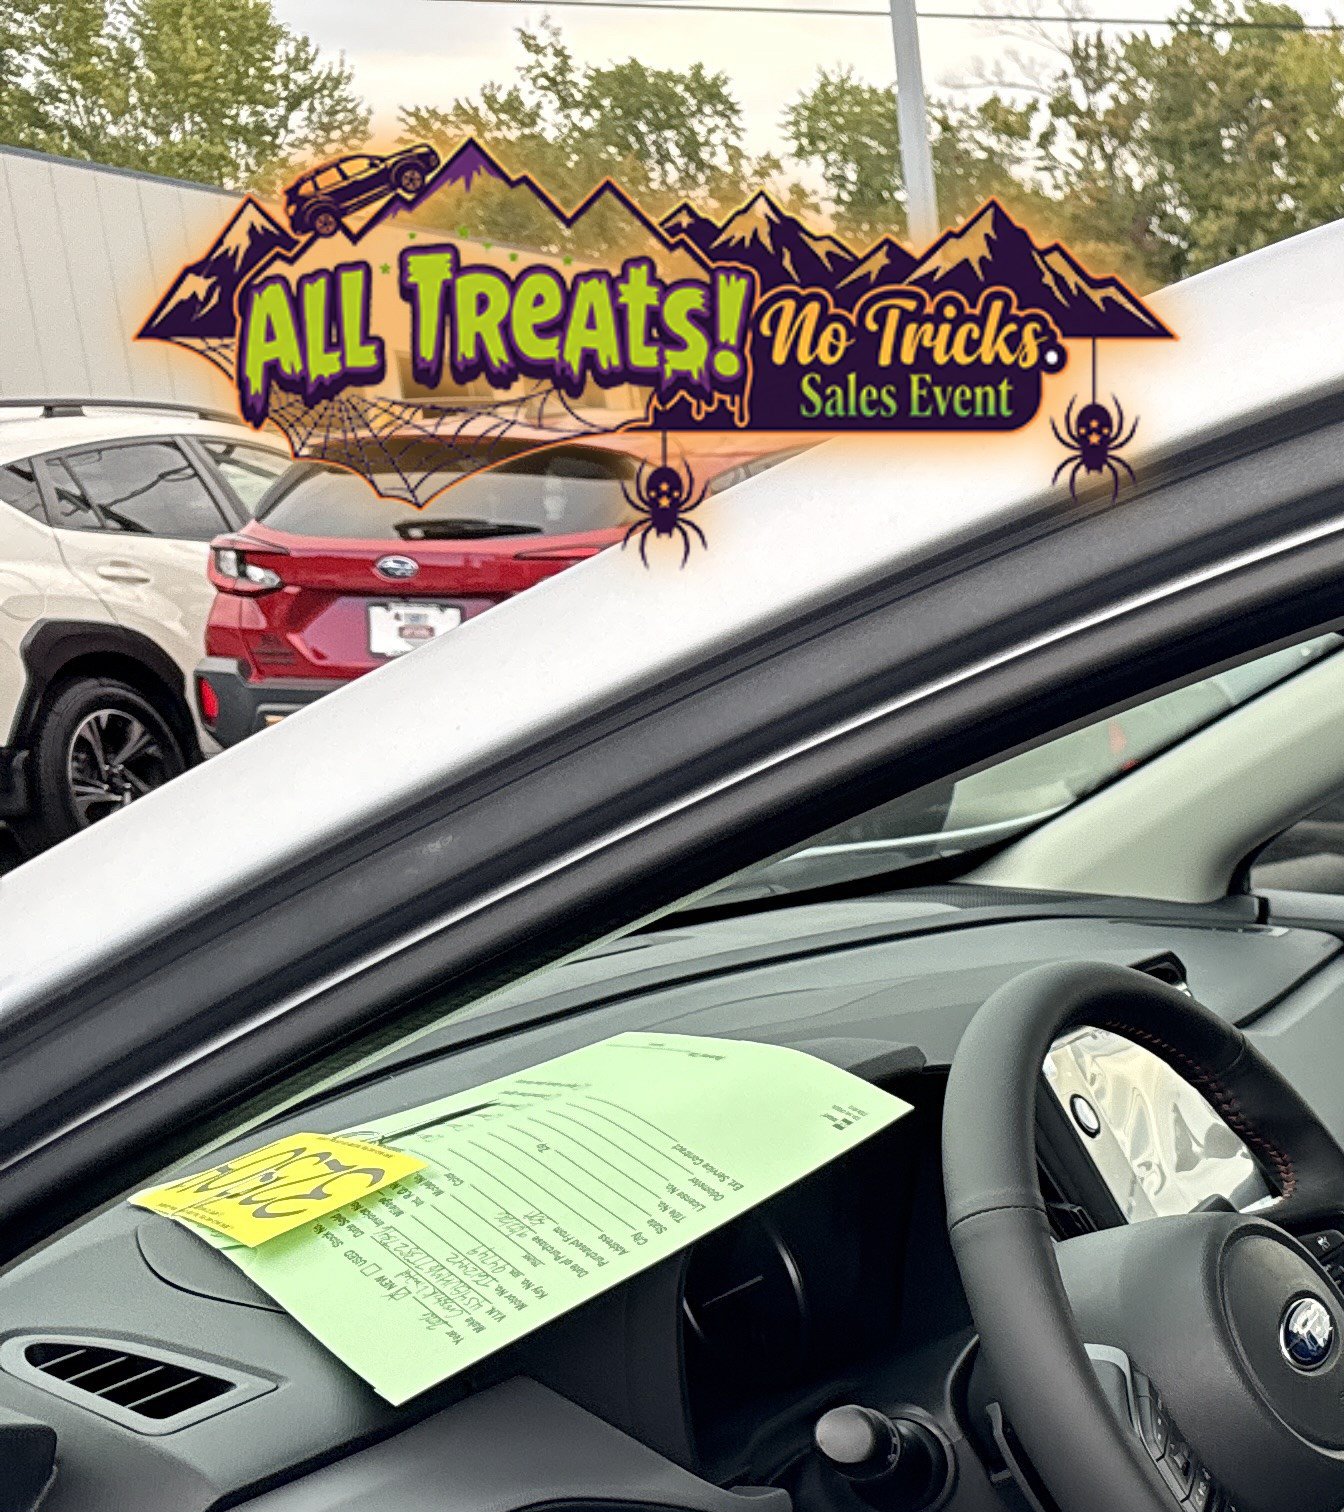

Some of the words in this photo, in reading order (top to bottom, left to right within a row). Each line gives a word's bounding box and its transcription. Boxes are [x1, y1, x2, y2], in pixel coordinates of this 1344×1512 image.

[442, 1172, 464, 1185] Color
[676, 1191, 704, 1210] License
[343, 1223, 365, 1237] Date
[551, 1226, 574, 1241] From
[645, 1219, 667, 1233] State
[320, 1231, 344, 1247] Stock
[596, 1234, 628, 1254] Address
[629, 1231, 649, 1244] City
[529, 1236, 565, 1259] Purchase
[570, 1240, 608, 1265] Purchased
[343, 1249, 368, 1265] USED
[569, 1263, 589, 1276] Date
[374, 1275, 397, 1289] NEW
[530, 1285, 550, 1298] Key
[504, 1293, 528, 1309] Motor
[464, 1316, 487, 1332] Make
[444, 1329, 465, 1344] Year
